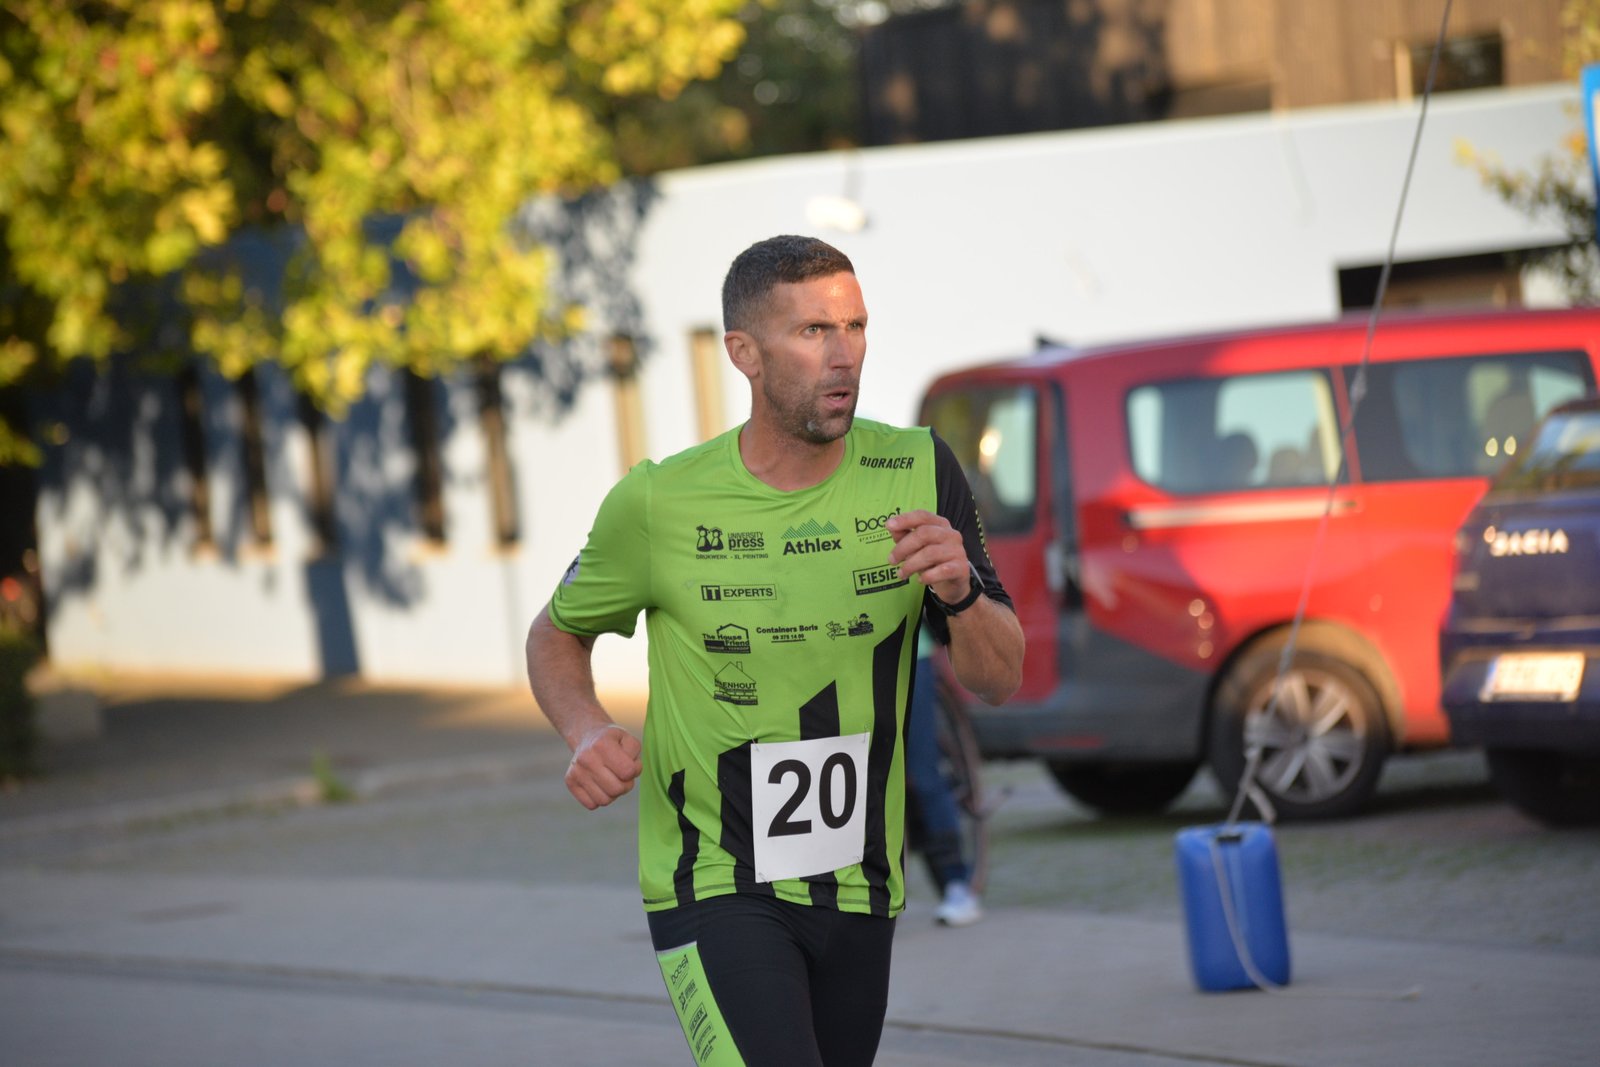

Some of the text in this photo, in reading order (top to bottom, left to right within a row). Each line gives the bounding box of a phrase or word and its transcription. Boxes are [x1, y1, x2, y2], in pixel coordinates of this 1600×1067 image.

[859, 456, 914, 470] BIORACER
[727, 531, 764, 539] UNIVERSITY
[728, 537, 765, 550] press
[782, 537, 842, 556] Athlex
[858, 566, 900, 586] FIESIE
[702, 586, 774, 600] IT EXPERTS
[756, 624, 818, 634] Containers Boris
[724, 639, 750, 647] Friend
[767, 751, 857, 838] 20
